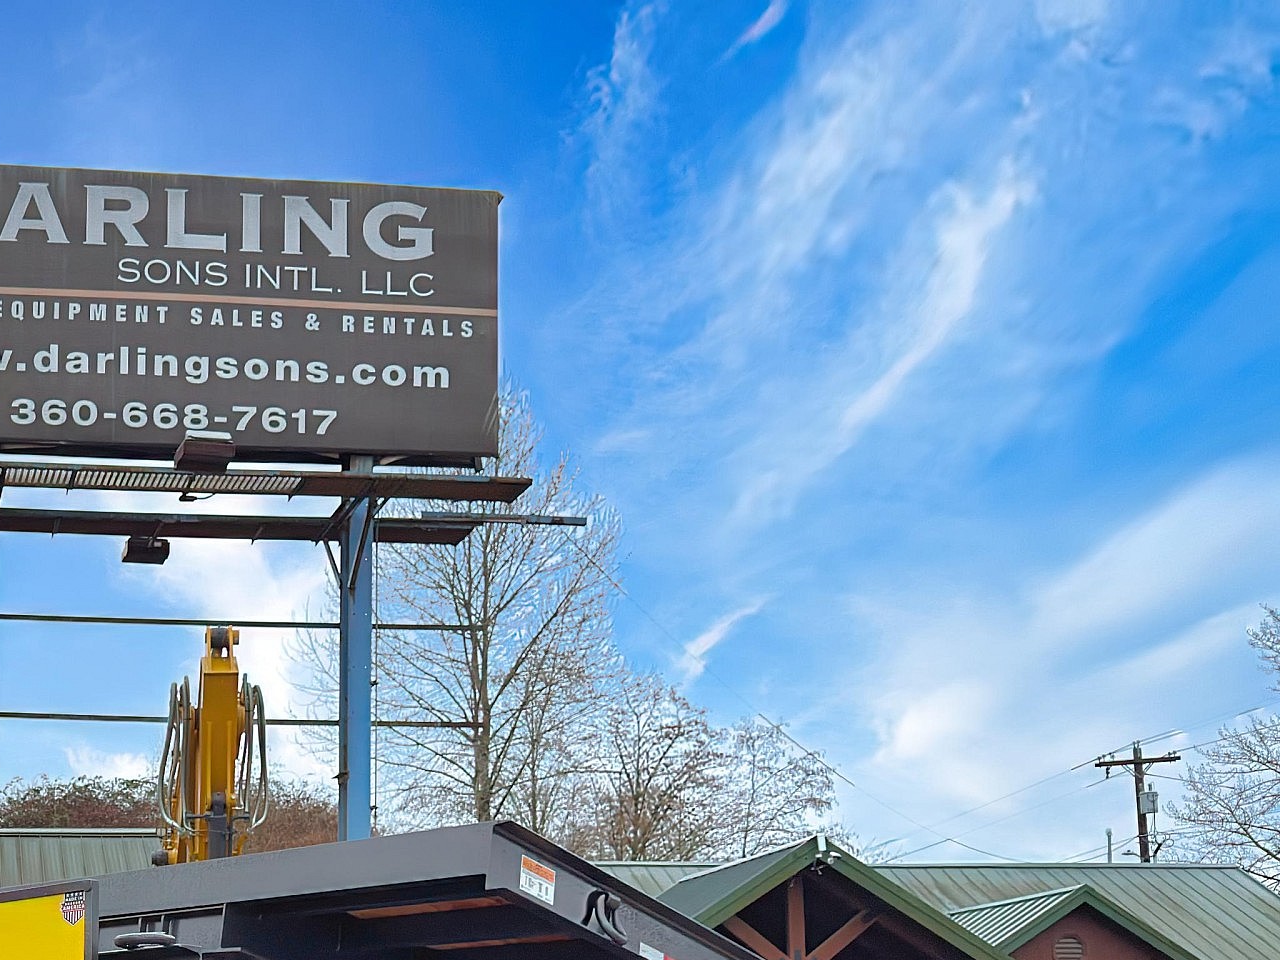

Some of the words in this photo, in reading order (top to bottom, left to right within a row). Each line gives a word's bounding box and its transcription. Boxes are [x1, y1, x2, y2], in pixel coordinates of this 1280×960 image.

[117, 257, 228, 287] SONS
[245, 263, 343, 294] INTL.
[361, 269, 435, 297] LLC
[190, 307, 283, 329] SALES
[305, 312, 321, 331] &
[342, 314, 474, 338] RENTALS
[10, 398, 338, 435] 360-668-7617
